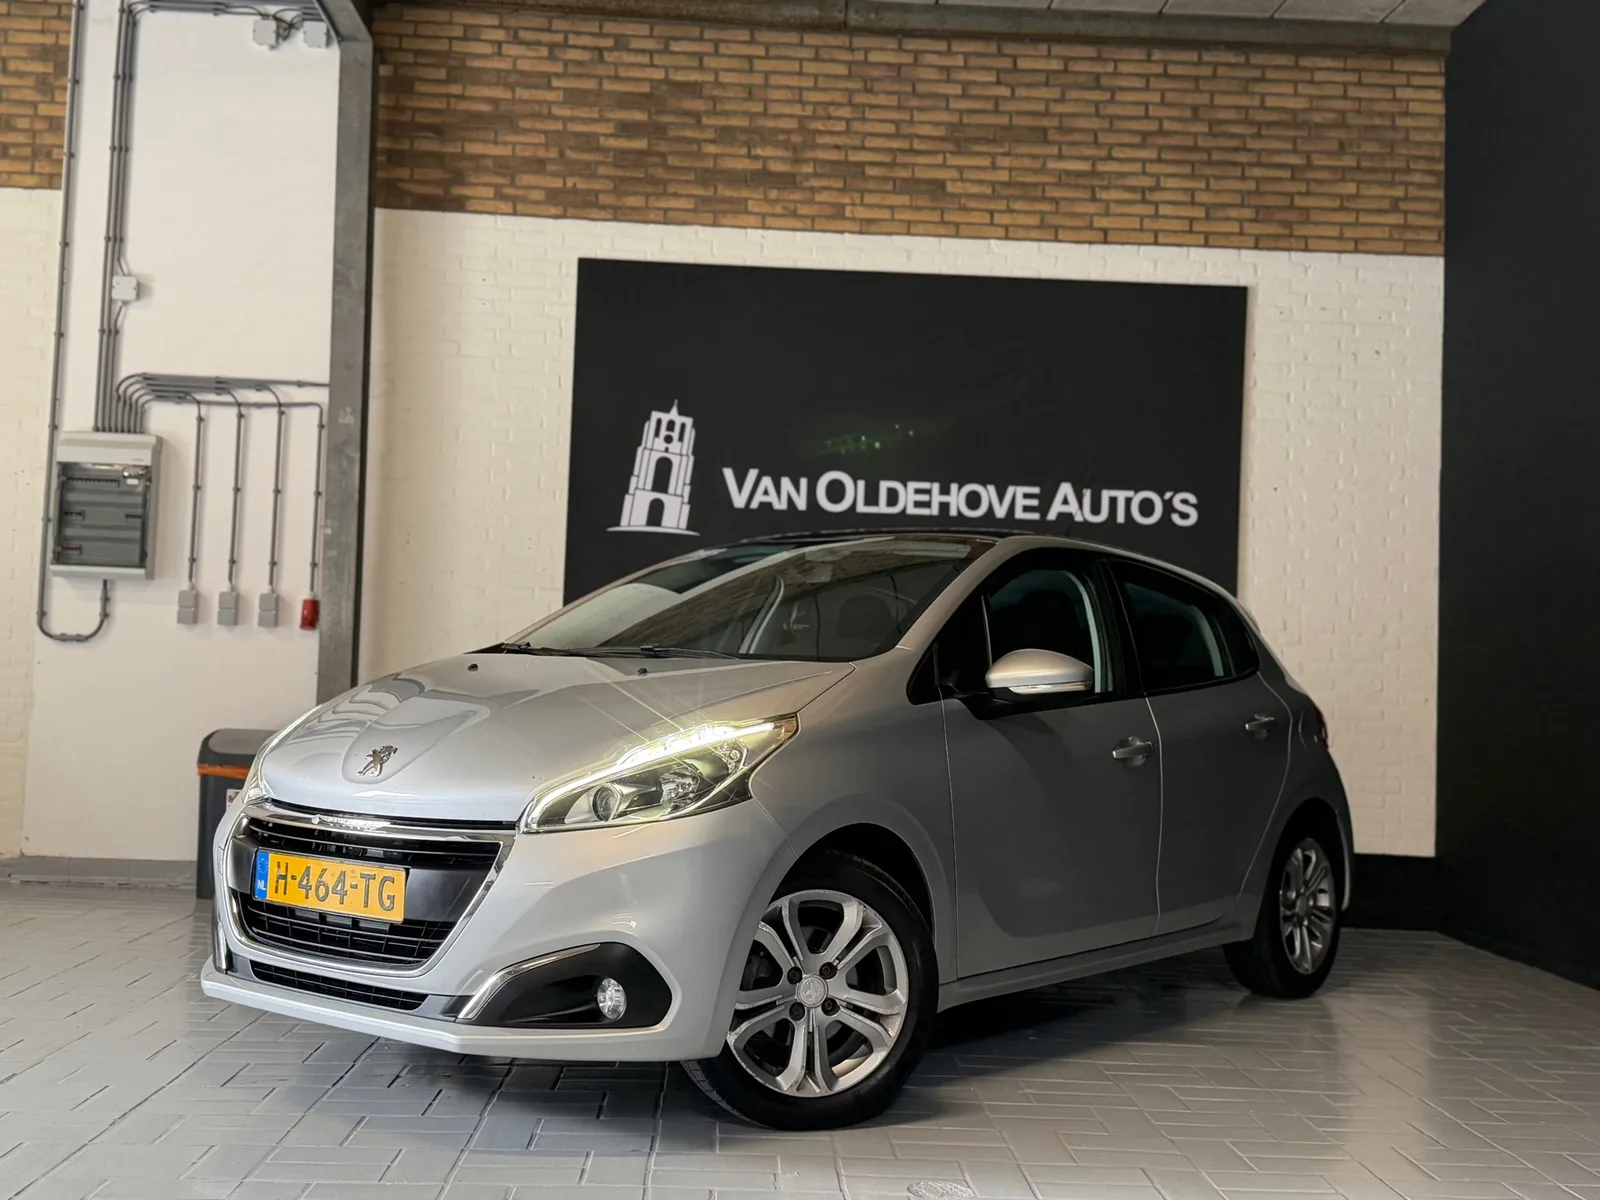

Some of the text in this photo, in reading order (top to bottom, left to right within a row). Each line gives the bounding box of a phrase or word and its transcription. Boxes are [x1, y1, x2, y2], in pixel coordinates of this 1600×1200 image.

[722, 468, 807, 510] VAN
[815, 471, 1041, 520] OLDEHOVE
[257, 880, 267, 891] NL
[274, 861, 396, 912] H-464-TG
